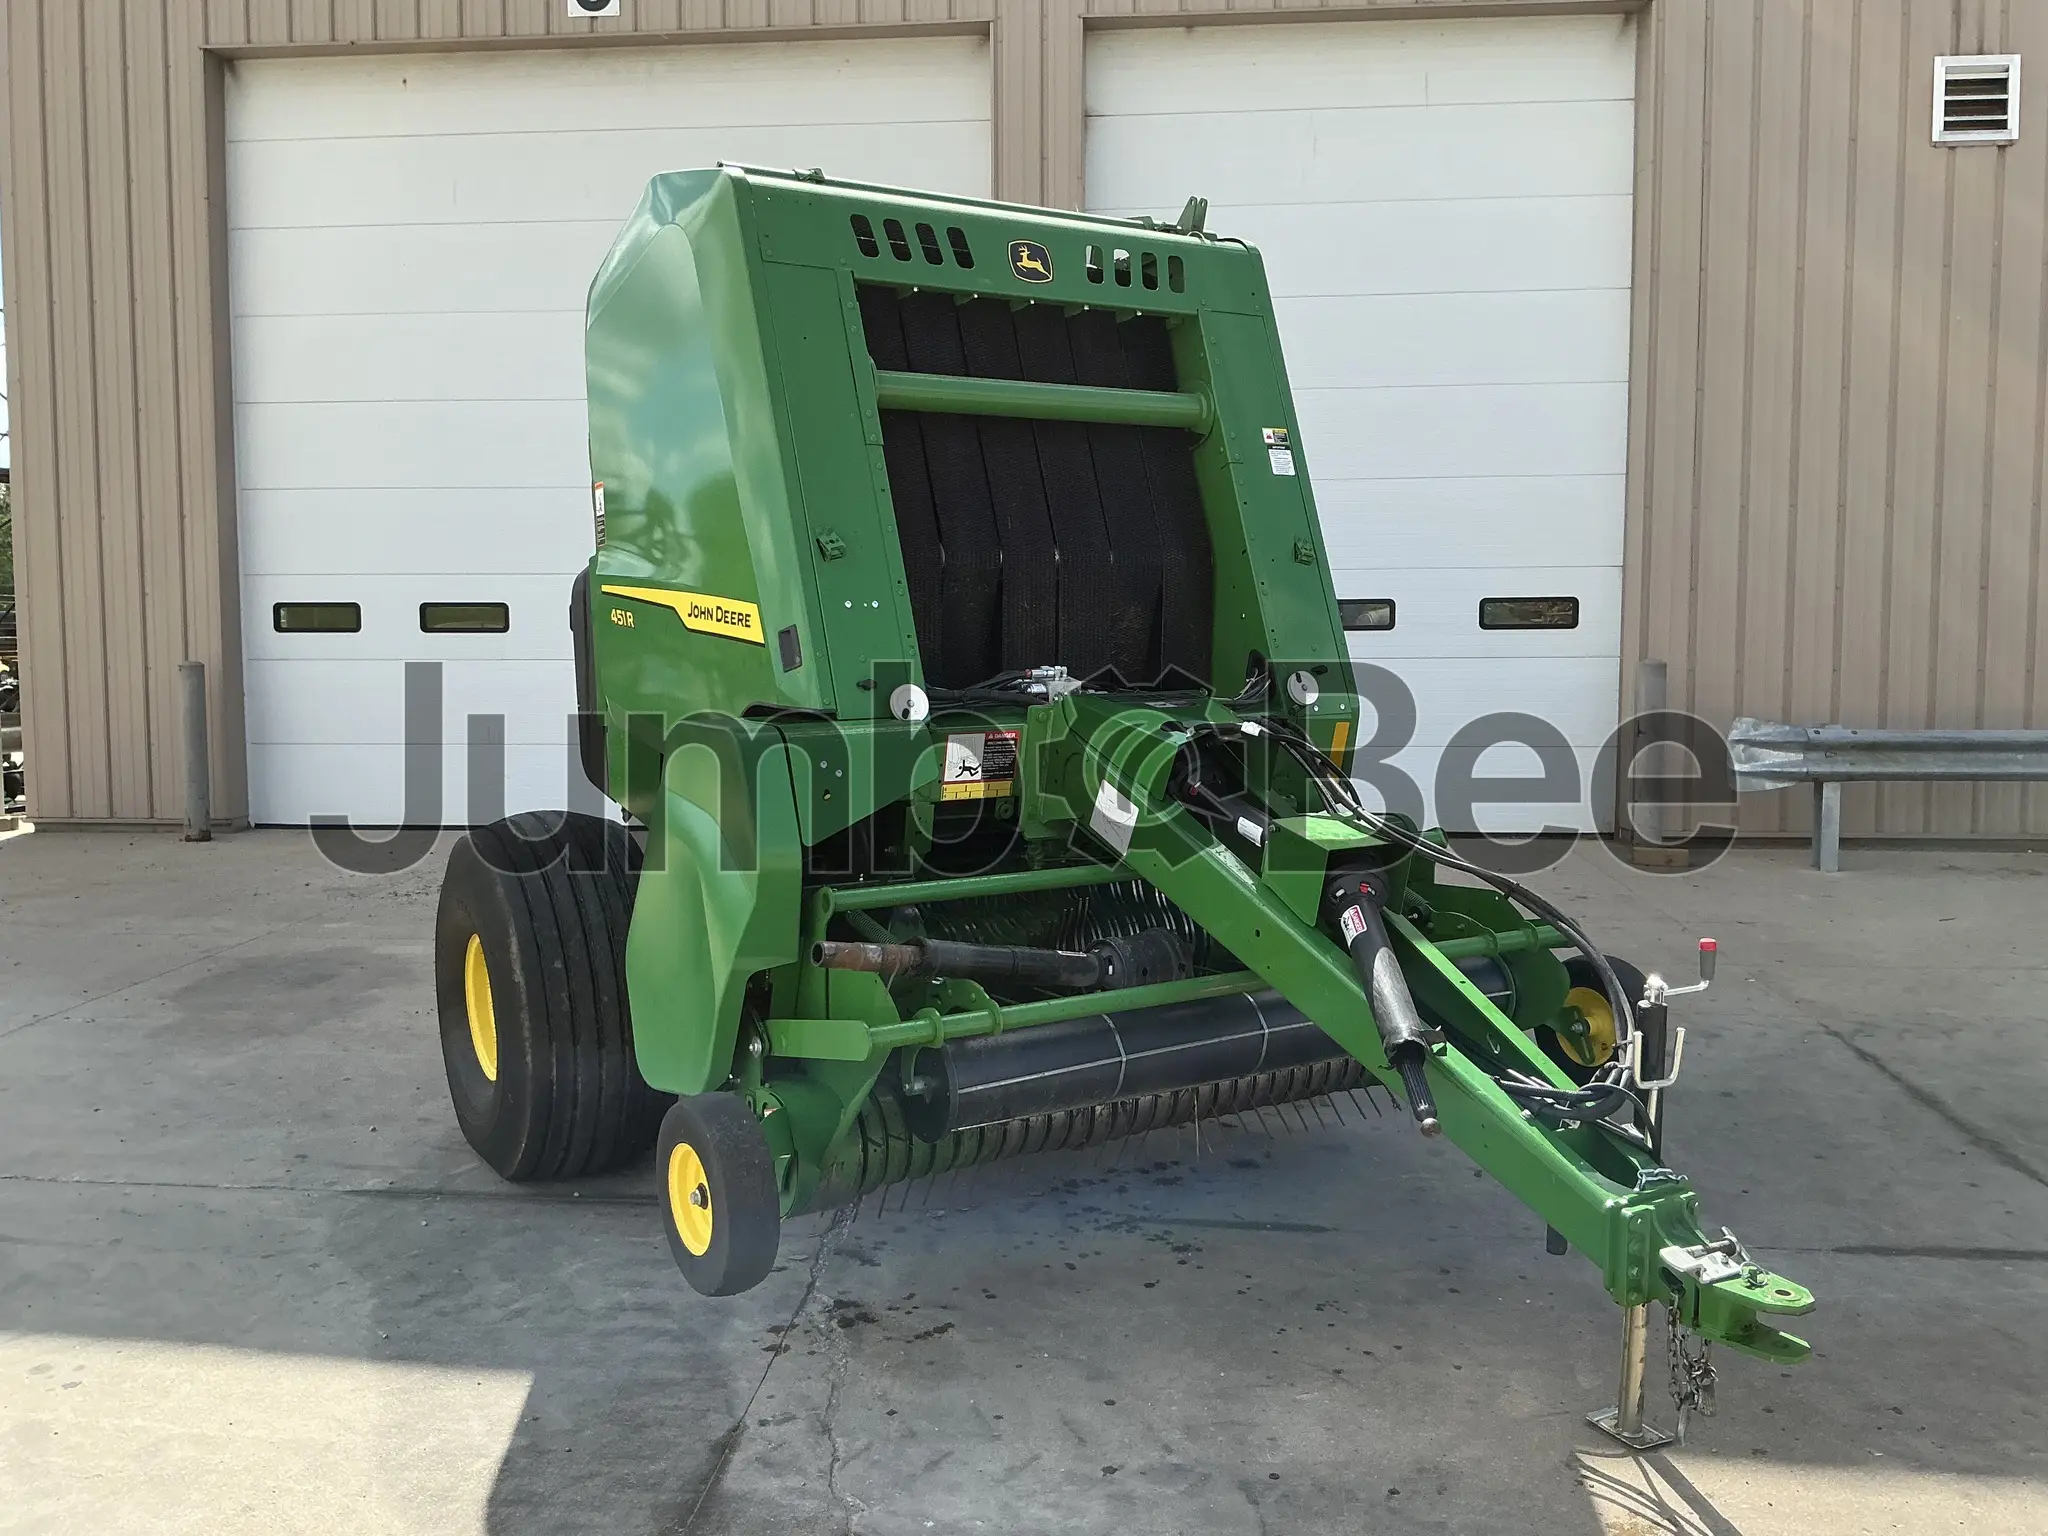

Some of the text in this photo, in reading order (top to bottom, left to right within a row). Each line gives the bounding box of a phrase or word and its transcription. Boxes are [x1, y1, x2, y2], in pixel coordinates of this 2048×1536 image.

[610, 608, 635, 628] 451R
[688, 601, 751, 628] JOHN DEERE
